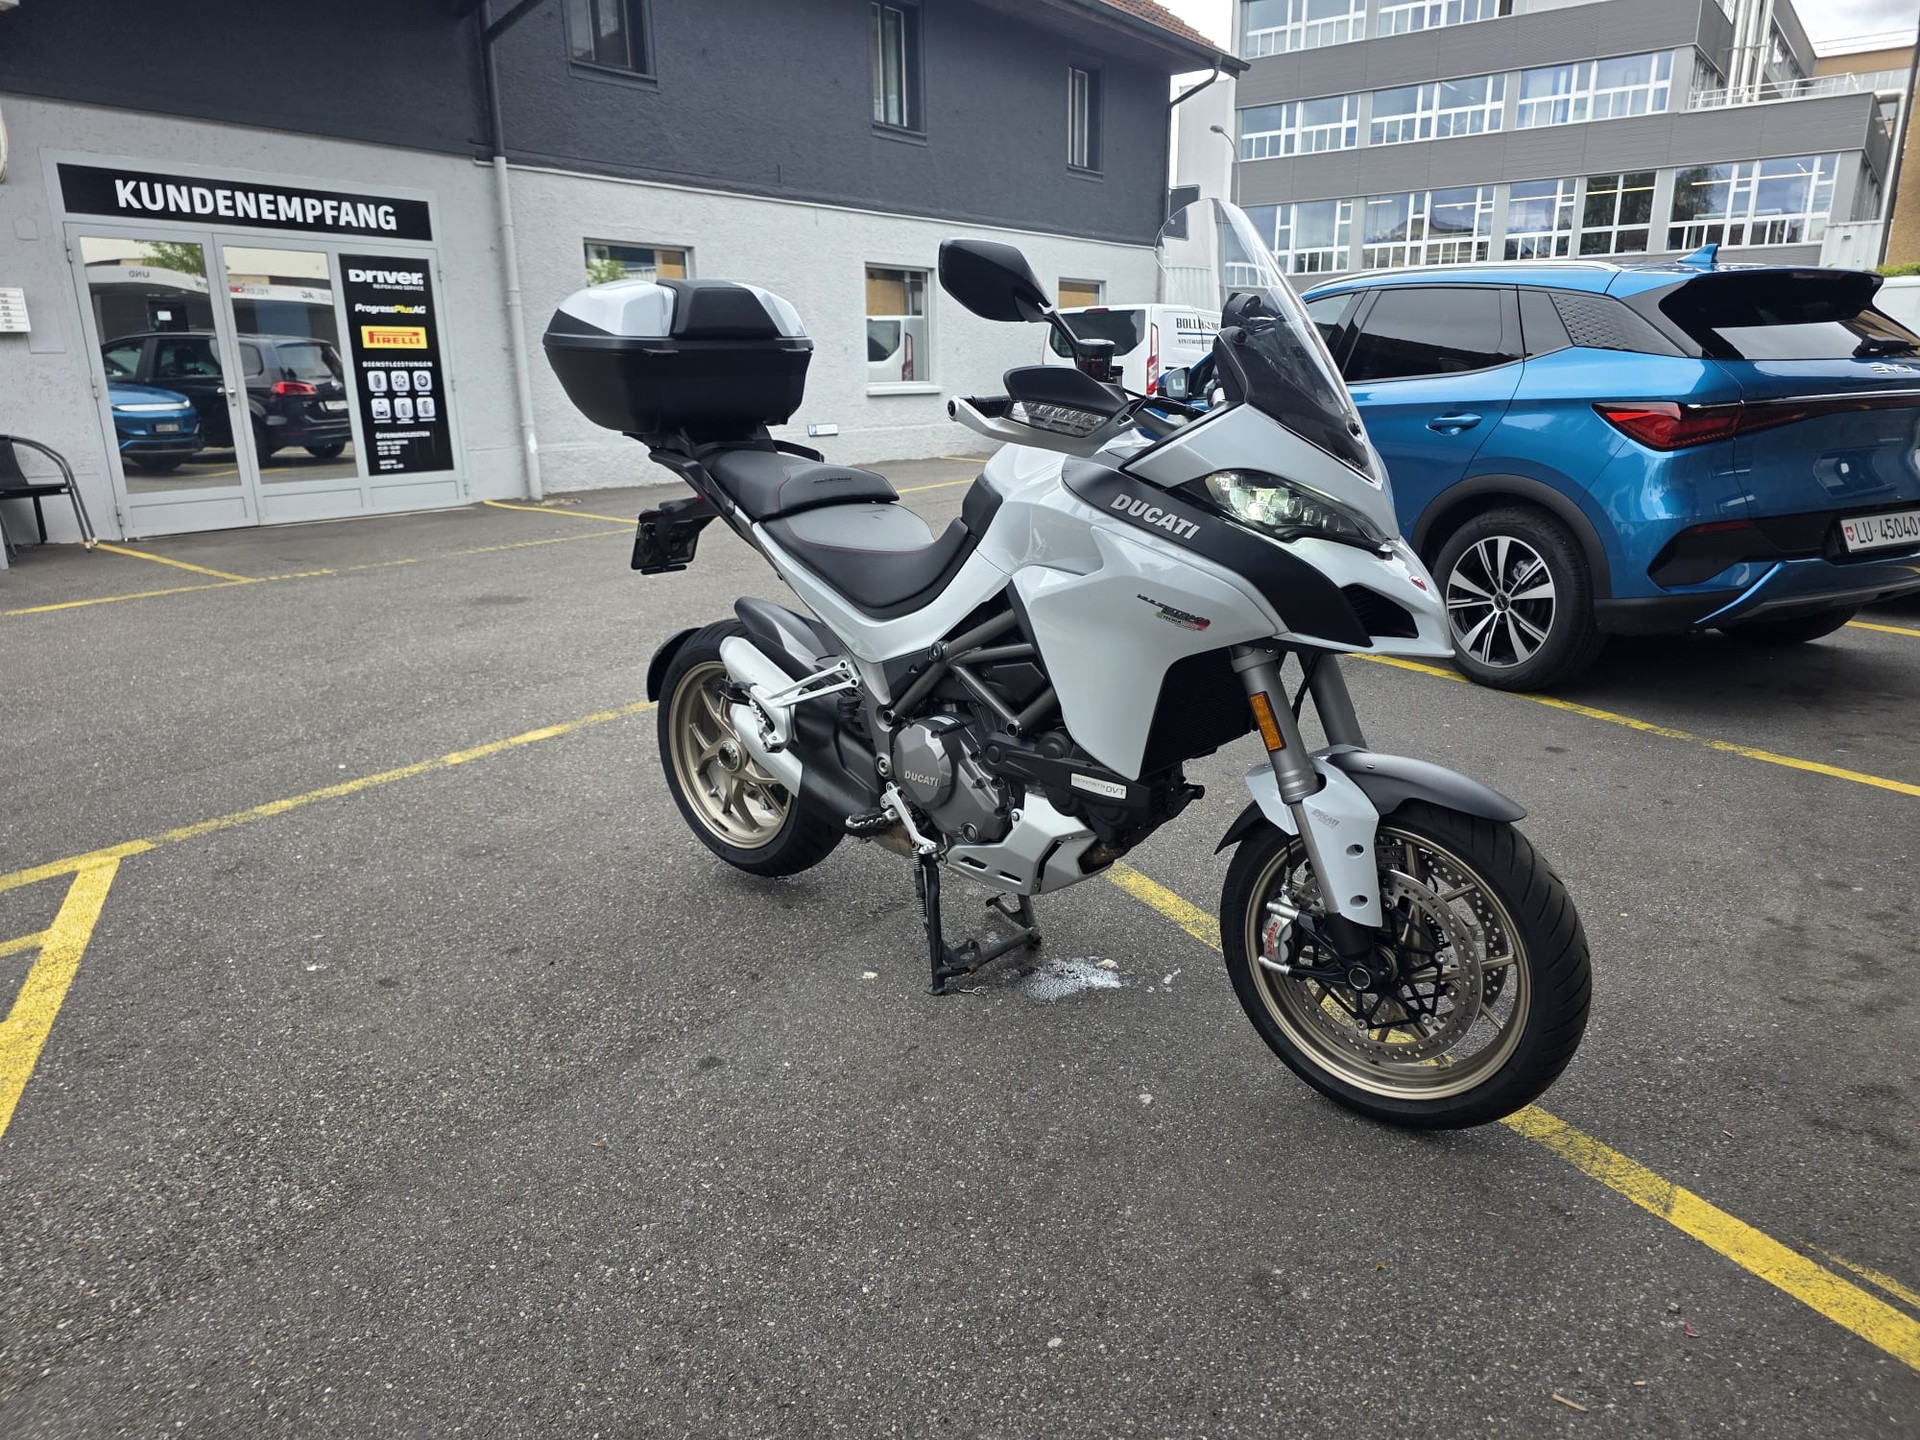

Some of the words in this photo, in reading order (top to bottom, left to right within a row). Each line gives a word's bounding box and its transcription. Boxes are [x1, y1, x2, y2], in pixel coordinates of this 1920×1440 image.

[114, 179, 398, 231] KUNDENEMPFANG
[368, 331, 420, 344] PIRELLI
[1110, 493, 1200, 540] DUCATI
[904, 770, 939, 787] DUCATI
[1105, 785, 1126, 795] DVT
[1266, 922, 1278, 956] brembo
